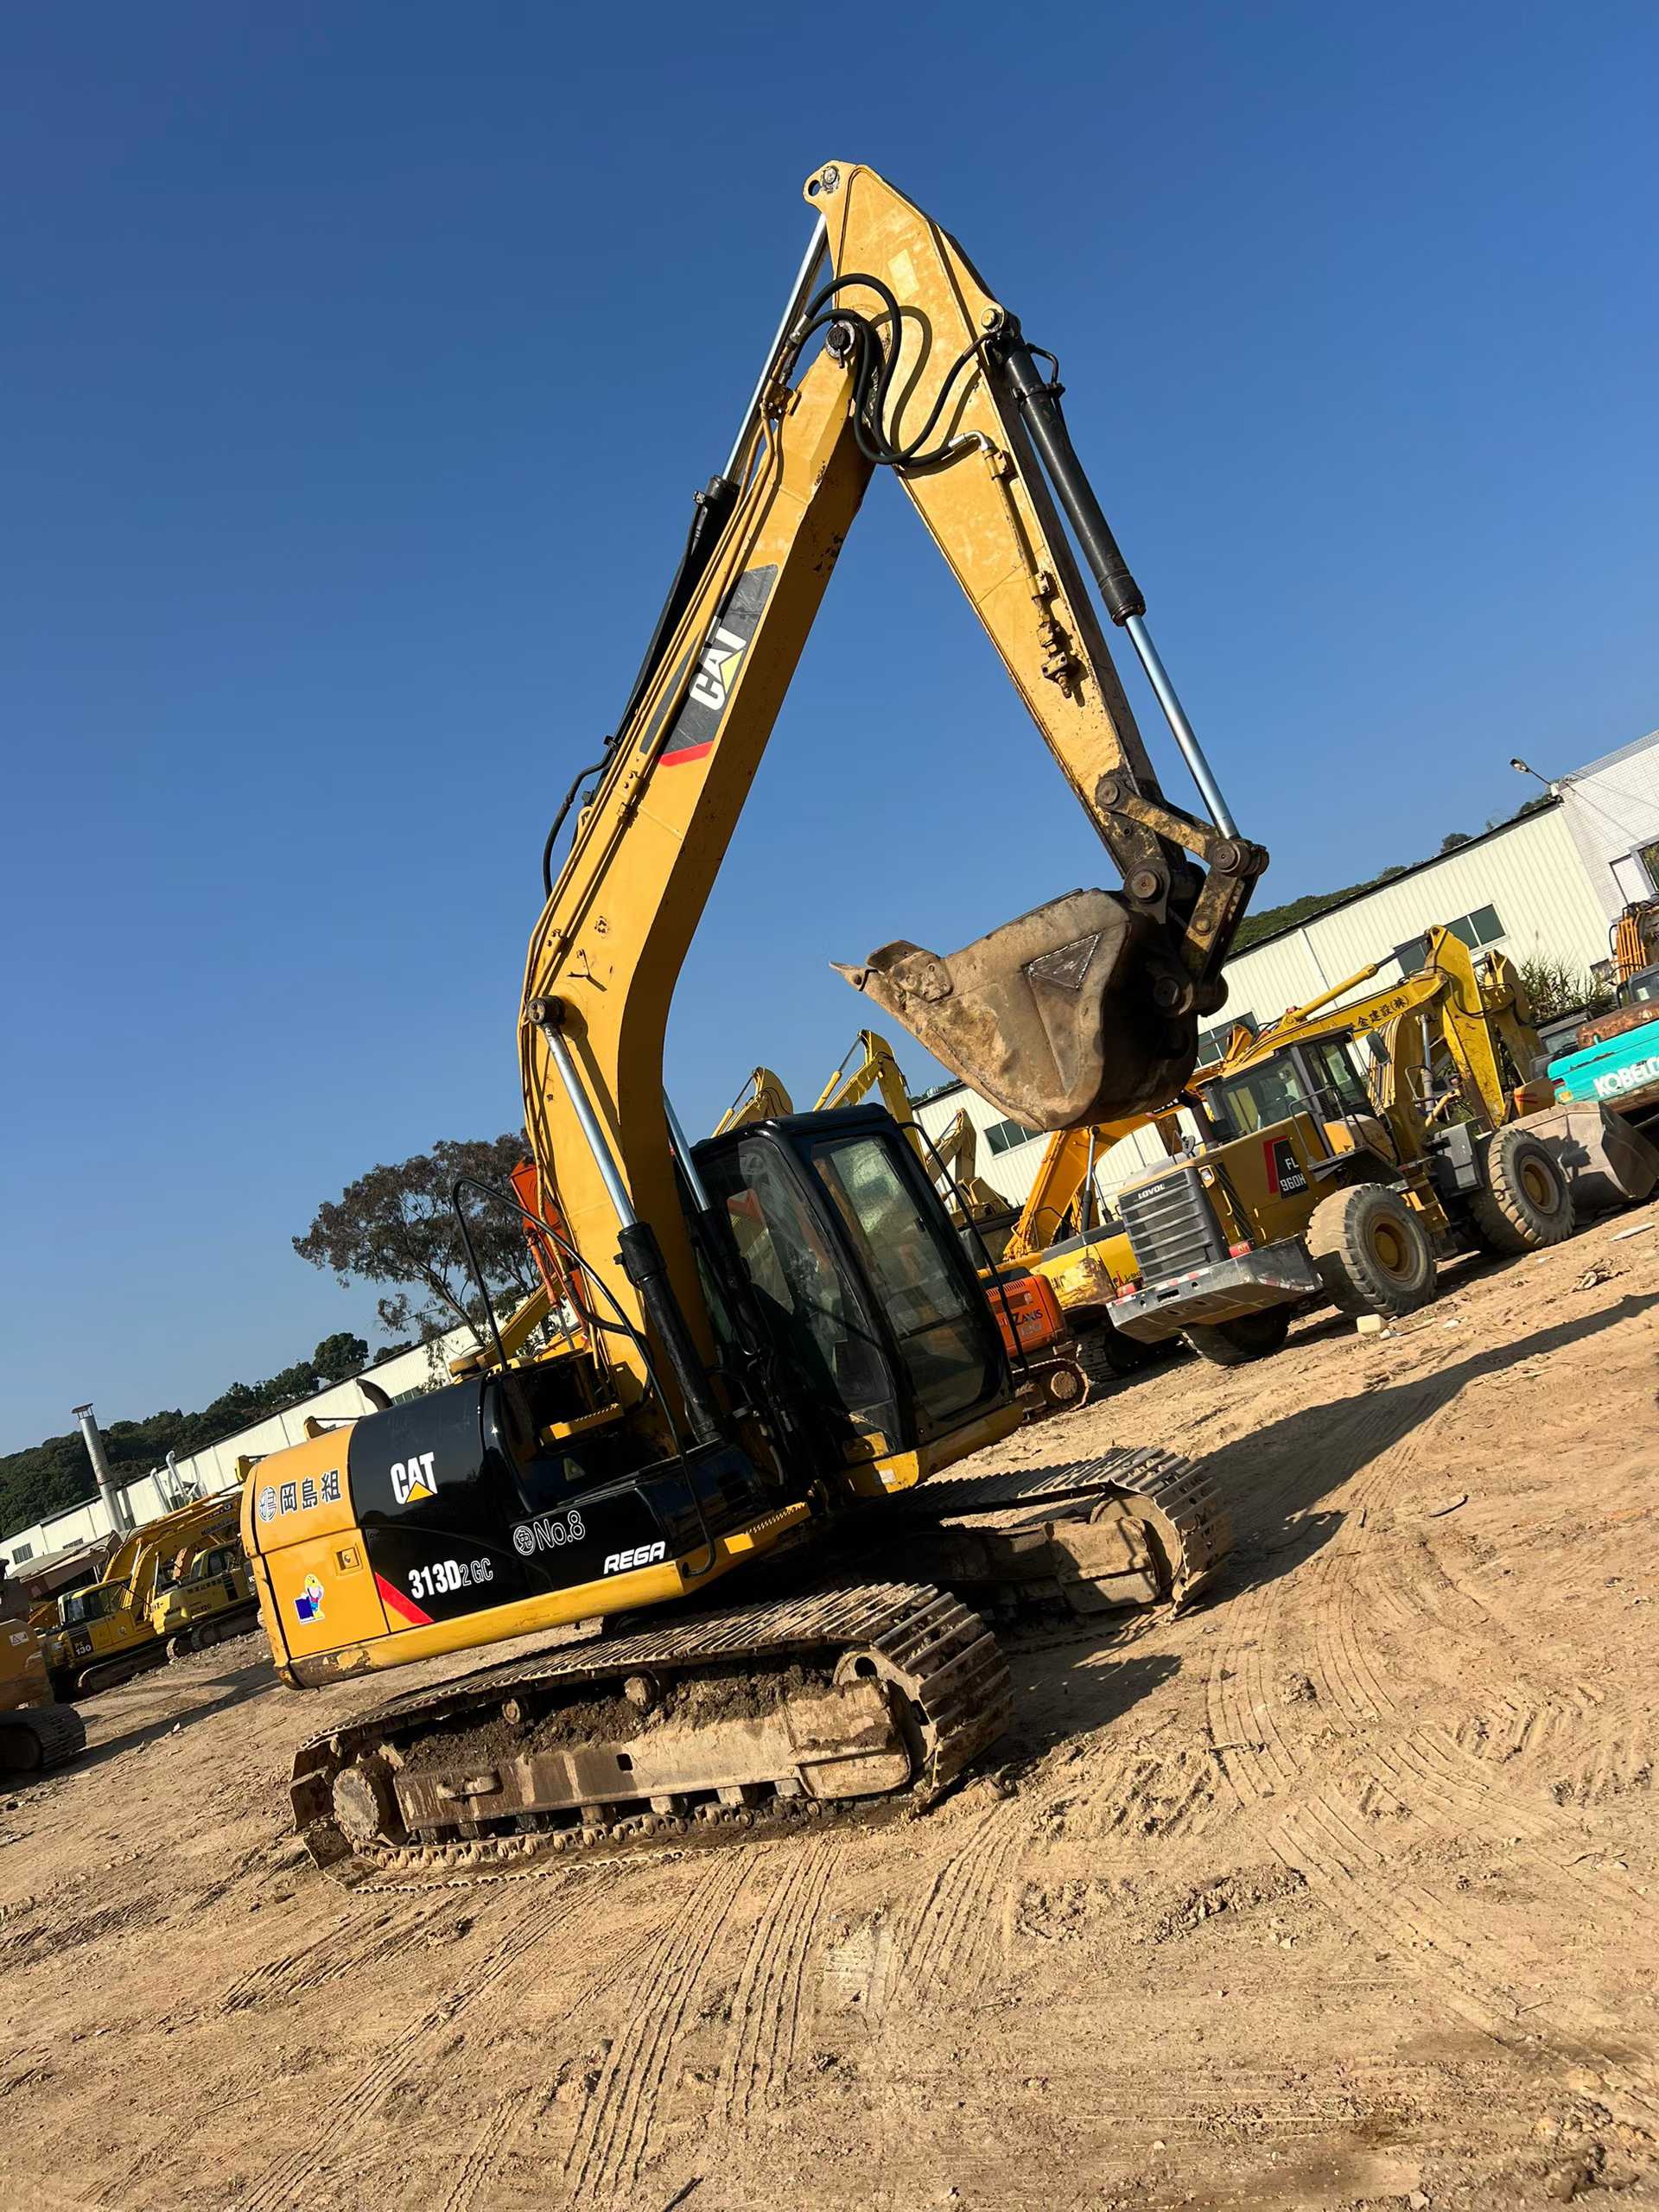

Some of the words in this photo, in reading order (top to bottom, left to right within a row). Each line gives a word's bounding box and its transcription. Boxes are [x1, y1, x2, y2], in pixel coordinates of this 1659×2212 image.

[690, 615, 747, 711] CAT
[1285, 1156, 1299, 1170] FL
[1137, 1183, 1166, 1199] LOVOL
[280, 1468, 342, 1516] 岡島組
[390, 1452, 438, 1504] CAT
[470, 1558, 494, 1584] GC
[603, 1541, 666, 1574] REGA
[75, 1644, 92, 1656] 130
